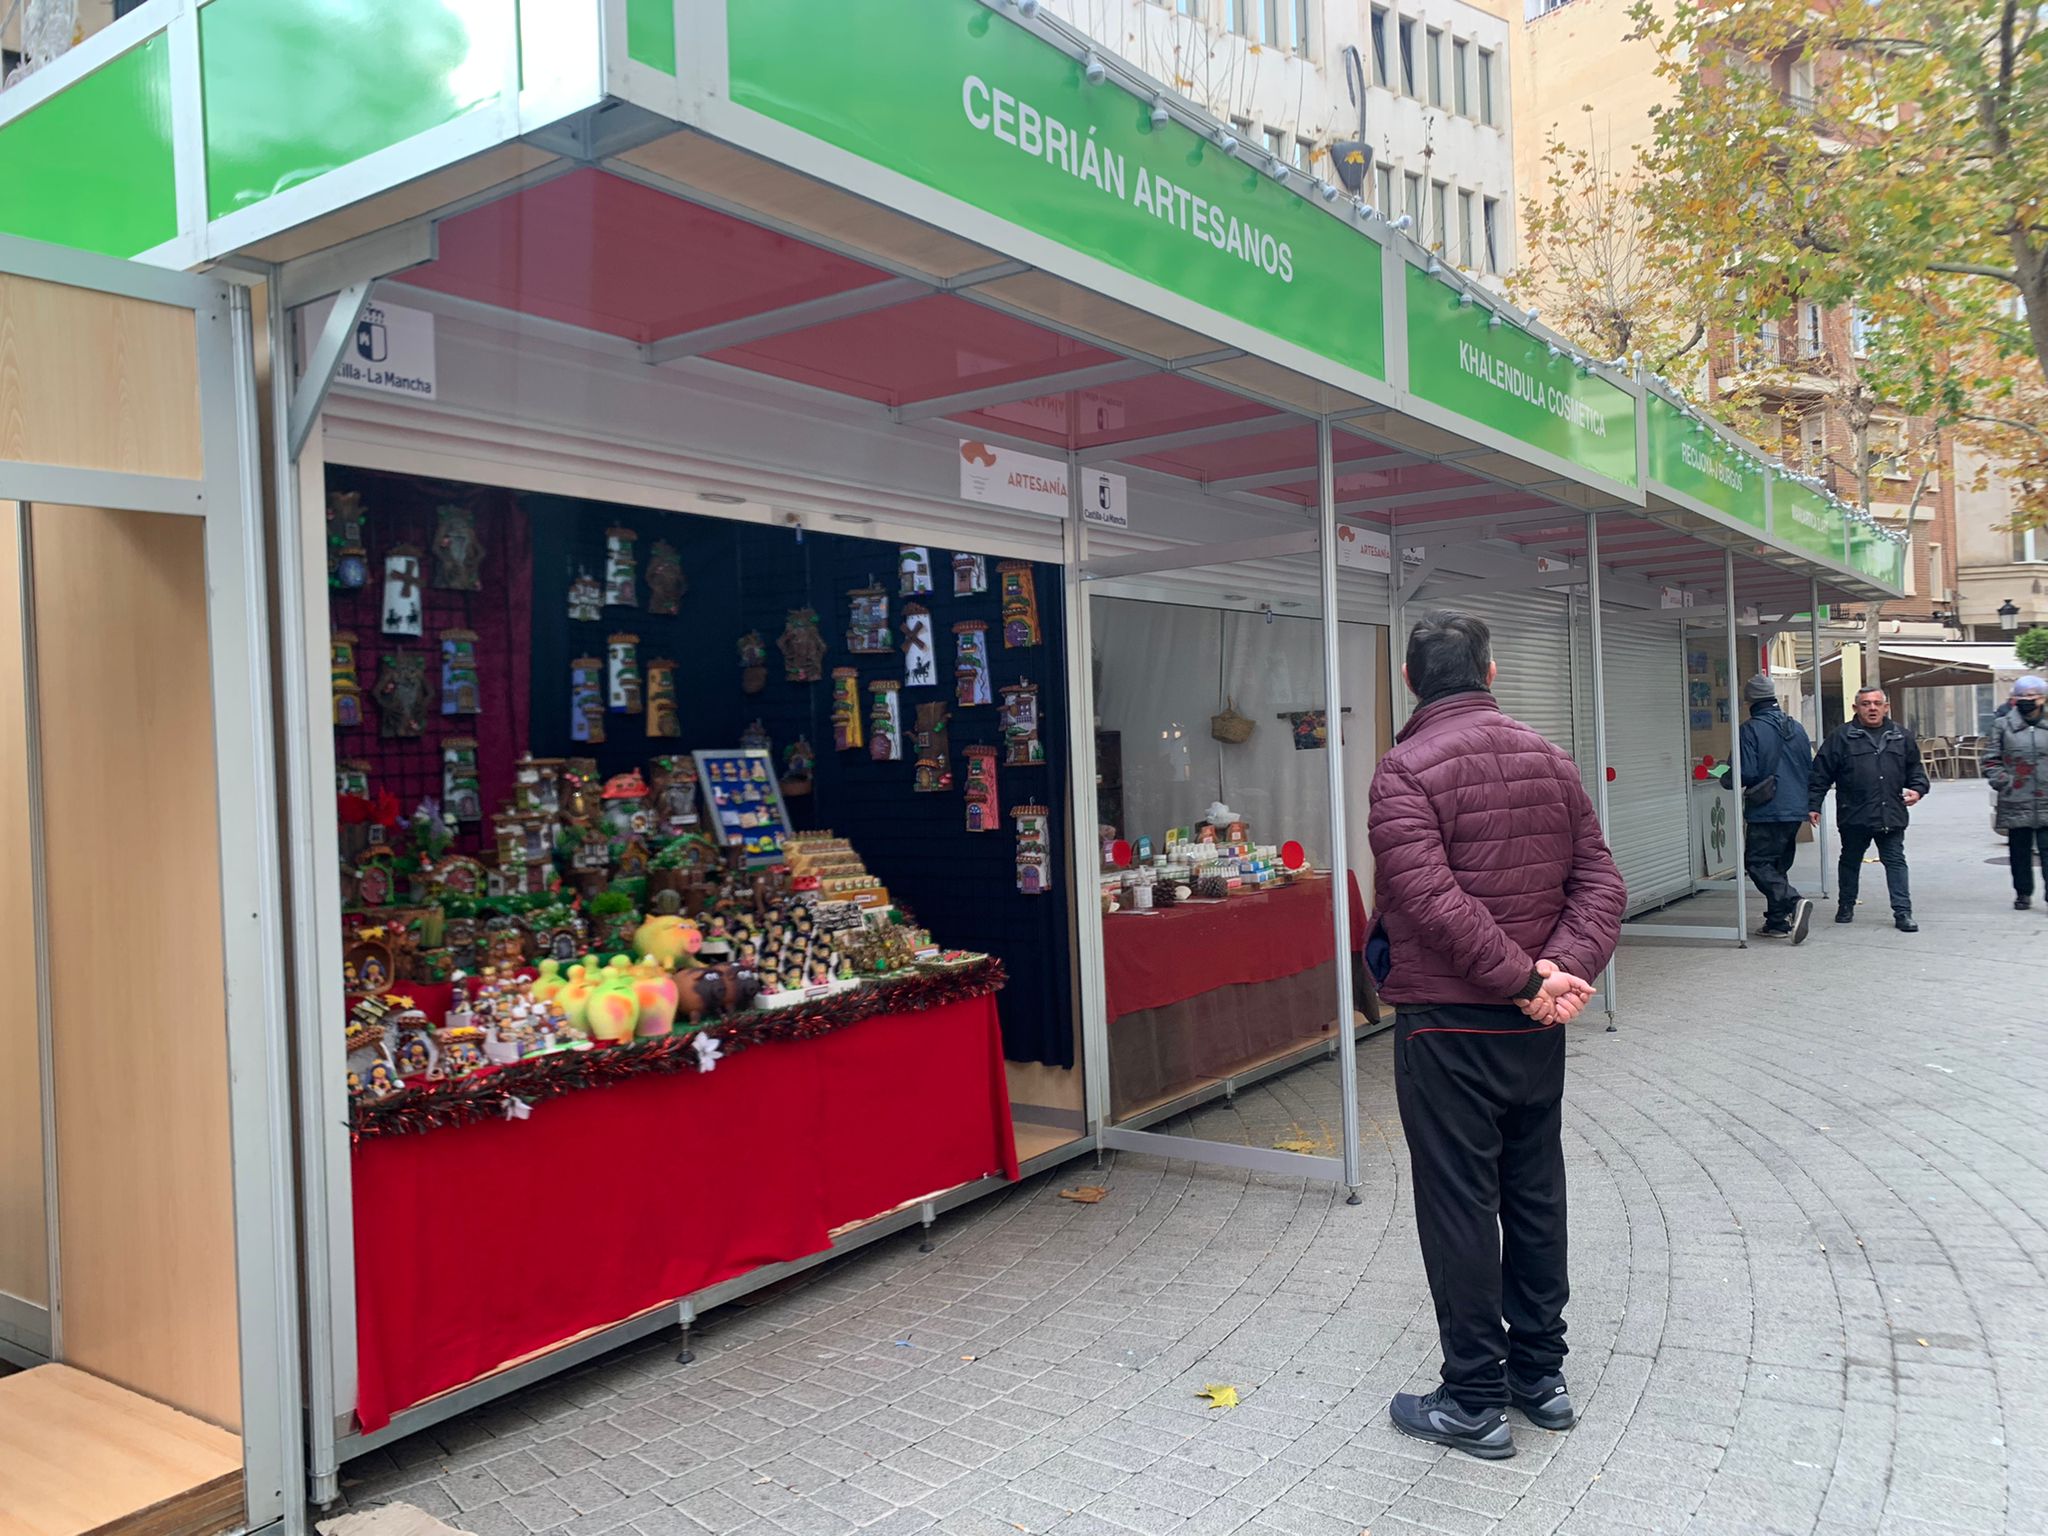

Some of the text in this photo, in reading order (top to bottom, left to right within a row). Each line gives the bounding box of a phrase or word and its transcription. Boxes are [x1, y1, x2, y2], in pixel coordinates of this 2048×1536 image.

[962, 75, 1293, 283] CEBRIÁN ARTESANOS
[384, 371, 432, 394] Mancha
[1459, 339, 1606, 438] KHALENDULA COSMÉTICA
[1008, 472, 1067, 496] ARTESANÍA
